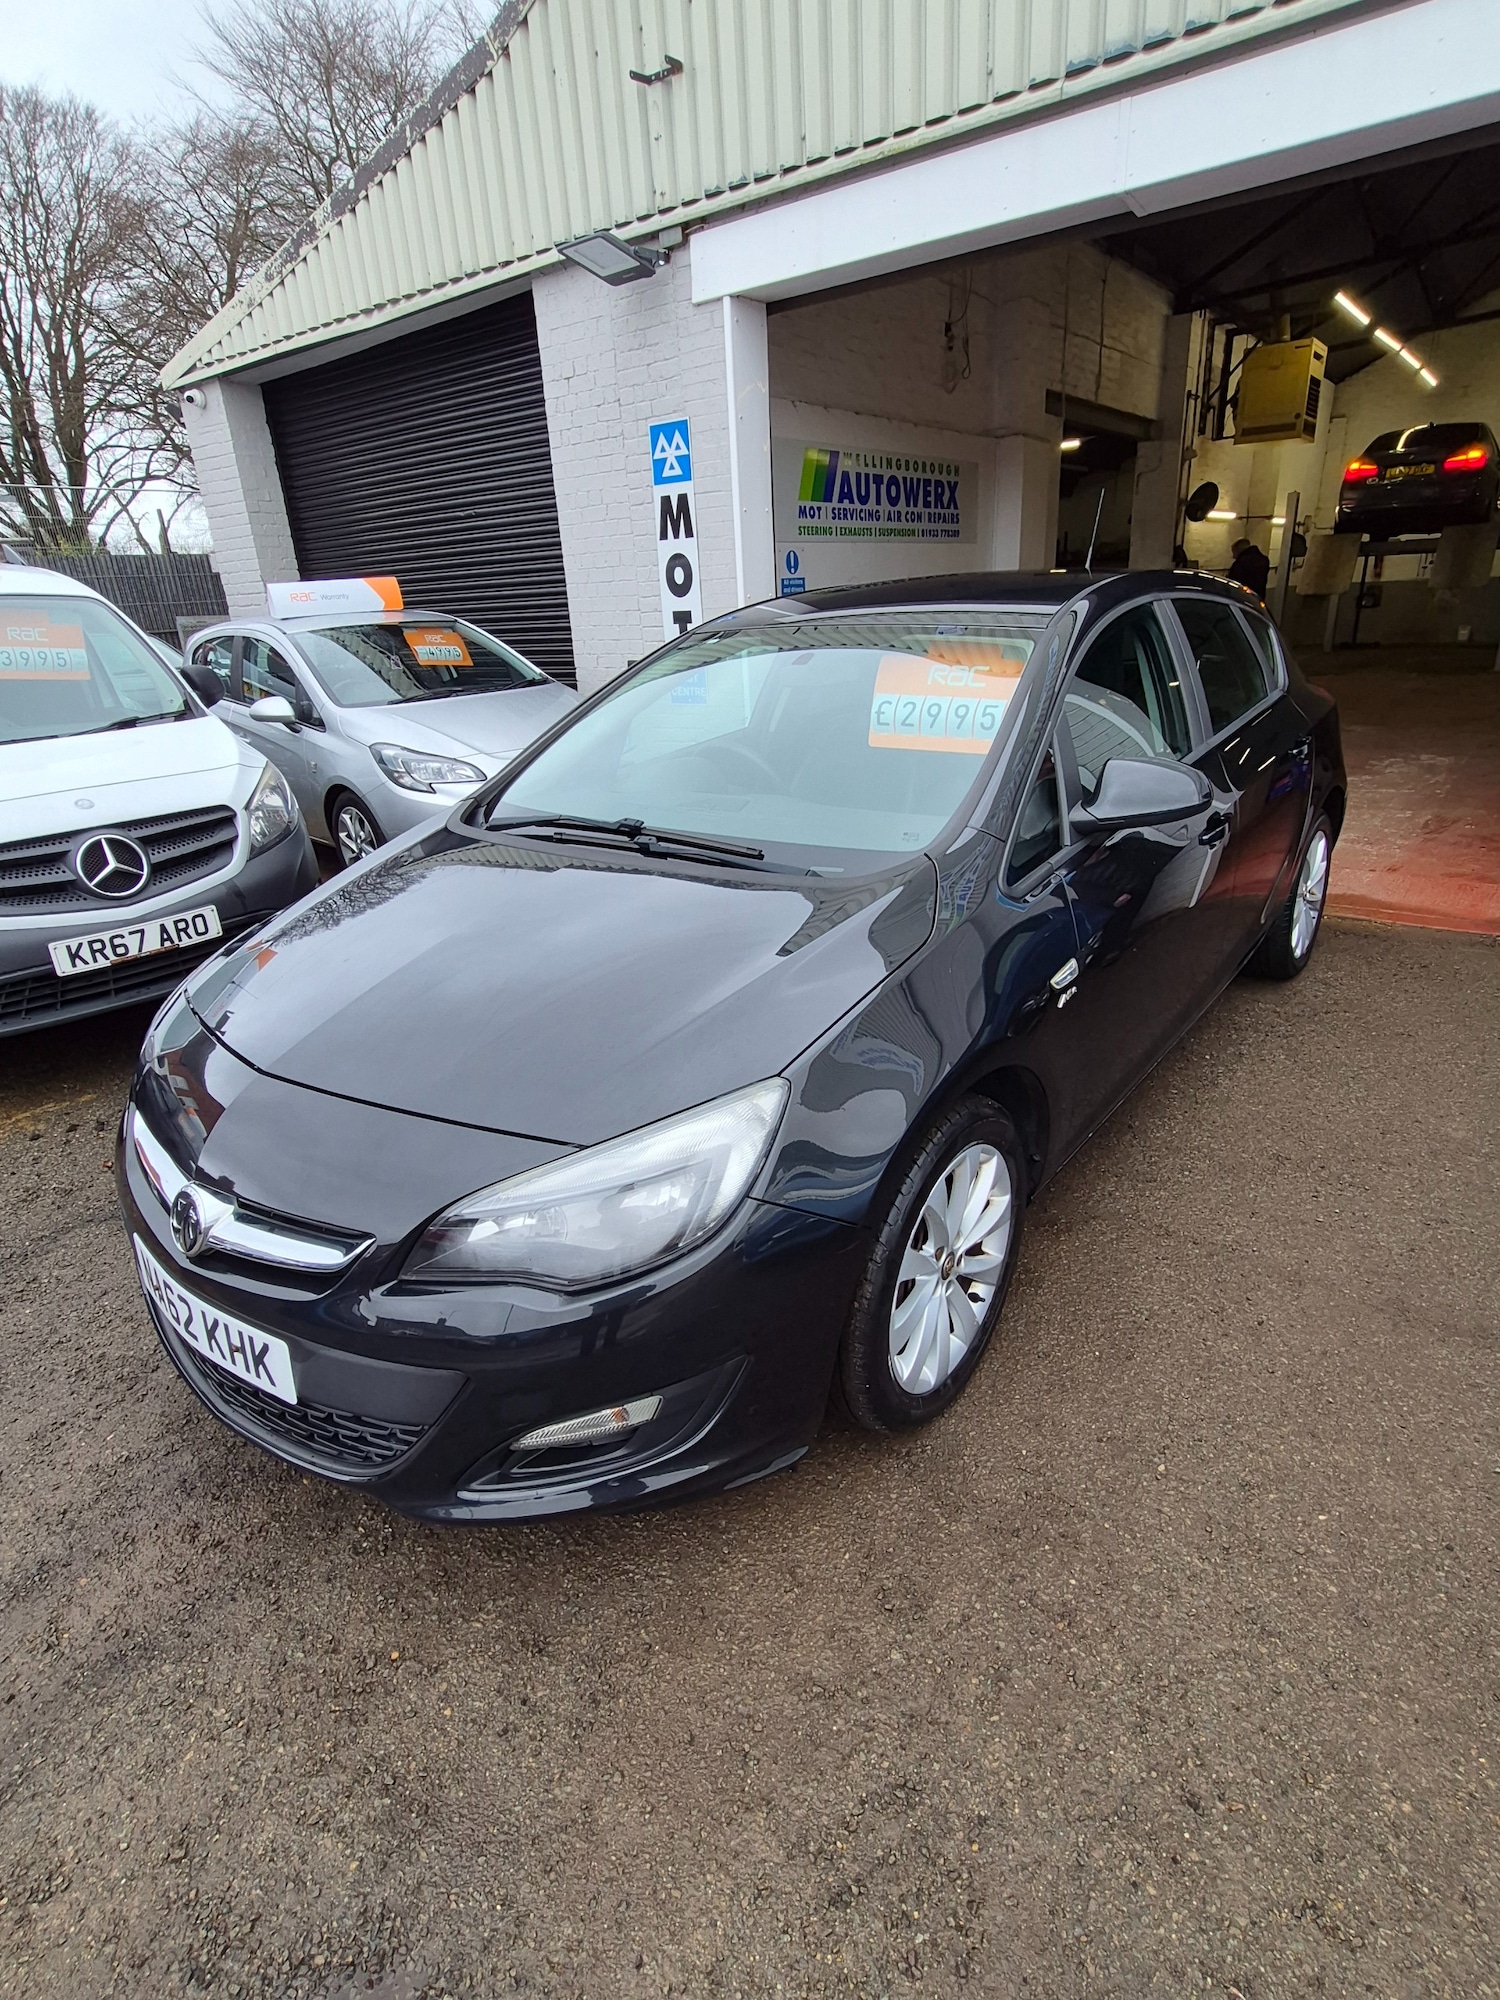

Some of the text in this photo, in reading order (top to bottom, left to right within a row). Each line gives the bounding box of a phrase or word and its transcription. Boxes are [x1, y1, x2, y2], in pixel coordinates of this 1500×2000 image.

[843, 452, 960, 477] WELLINGBOROUGH
[837, 470, 959, 510] AUTOWERX
[798, 505, 960, 525] MOT SERVICING AIR CON REPAIRS
[798, 525, 833, 536] STEERING
[839, 526, 873, 537] EXHAUSTS
[878, 527, 916, 538] SUSPENSION
[921, 528, 939, 538] 01933
[658, 492, 694, 635] MOT
[319, 593, 349, 601] Warranty
[0, 650, 68, 668] 3995
[428, 646, 461, 658] 4995
[671, 686, 706, 697] CENTRE
[874, 700, 1000, 731] £2995
[65, 913, 210, 969] KR67 ARO
[201, 1310, 277, 1388] KHK
